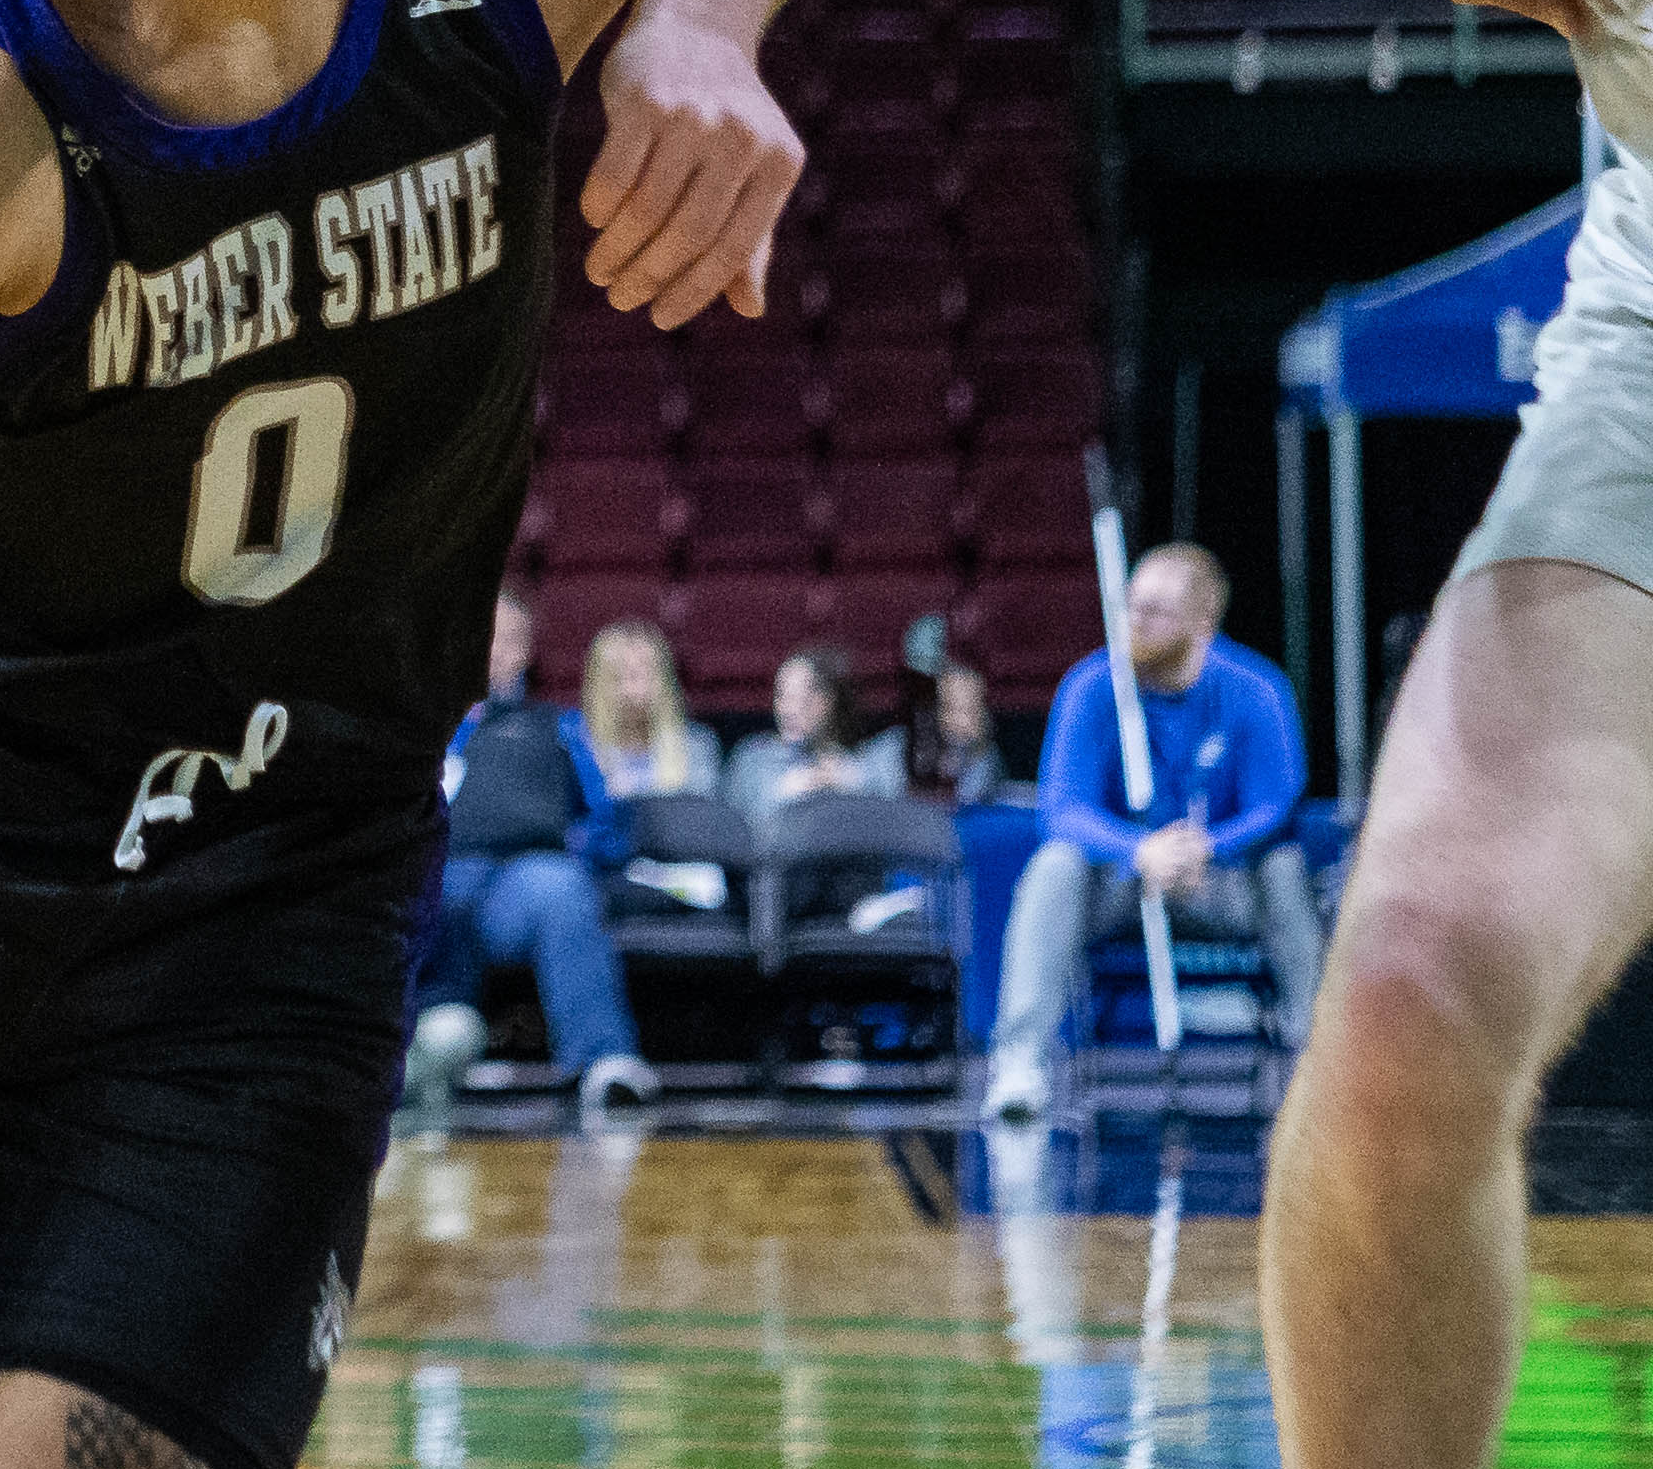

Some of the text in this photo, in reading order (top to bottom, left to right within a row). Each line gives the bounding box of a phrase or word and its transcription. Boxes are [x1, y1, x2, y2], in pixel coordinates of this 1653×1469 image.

[87, 133, 504, 393] WEBER STATE
[179, 374, 356, 608] 0
